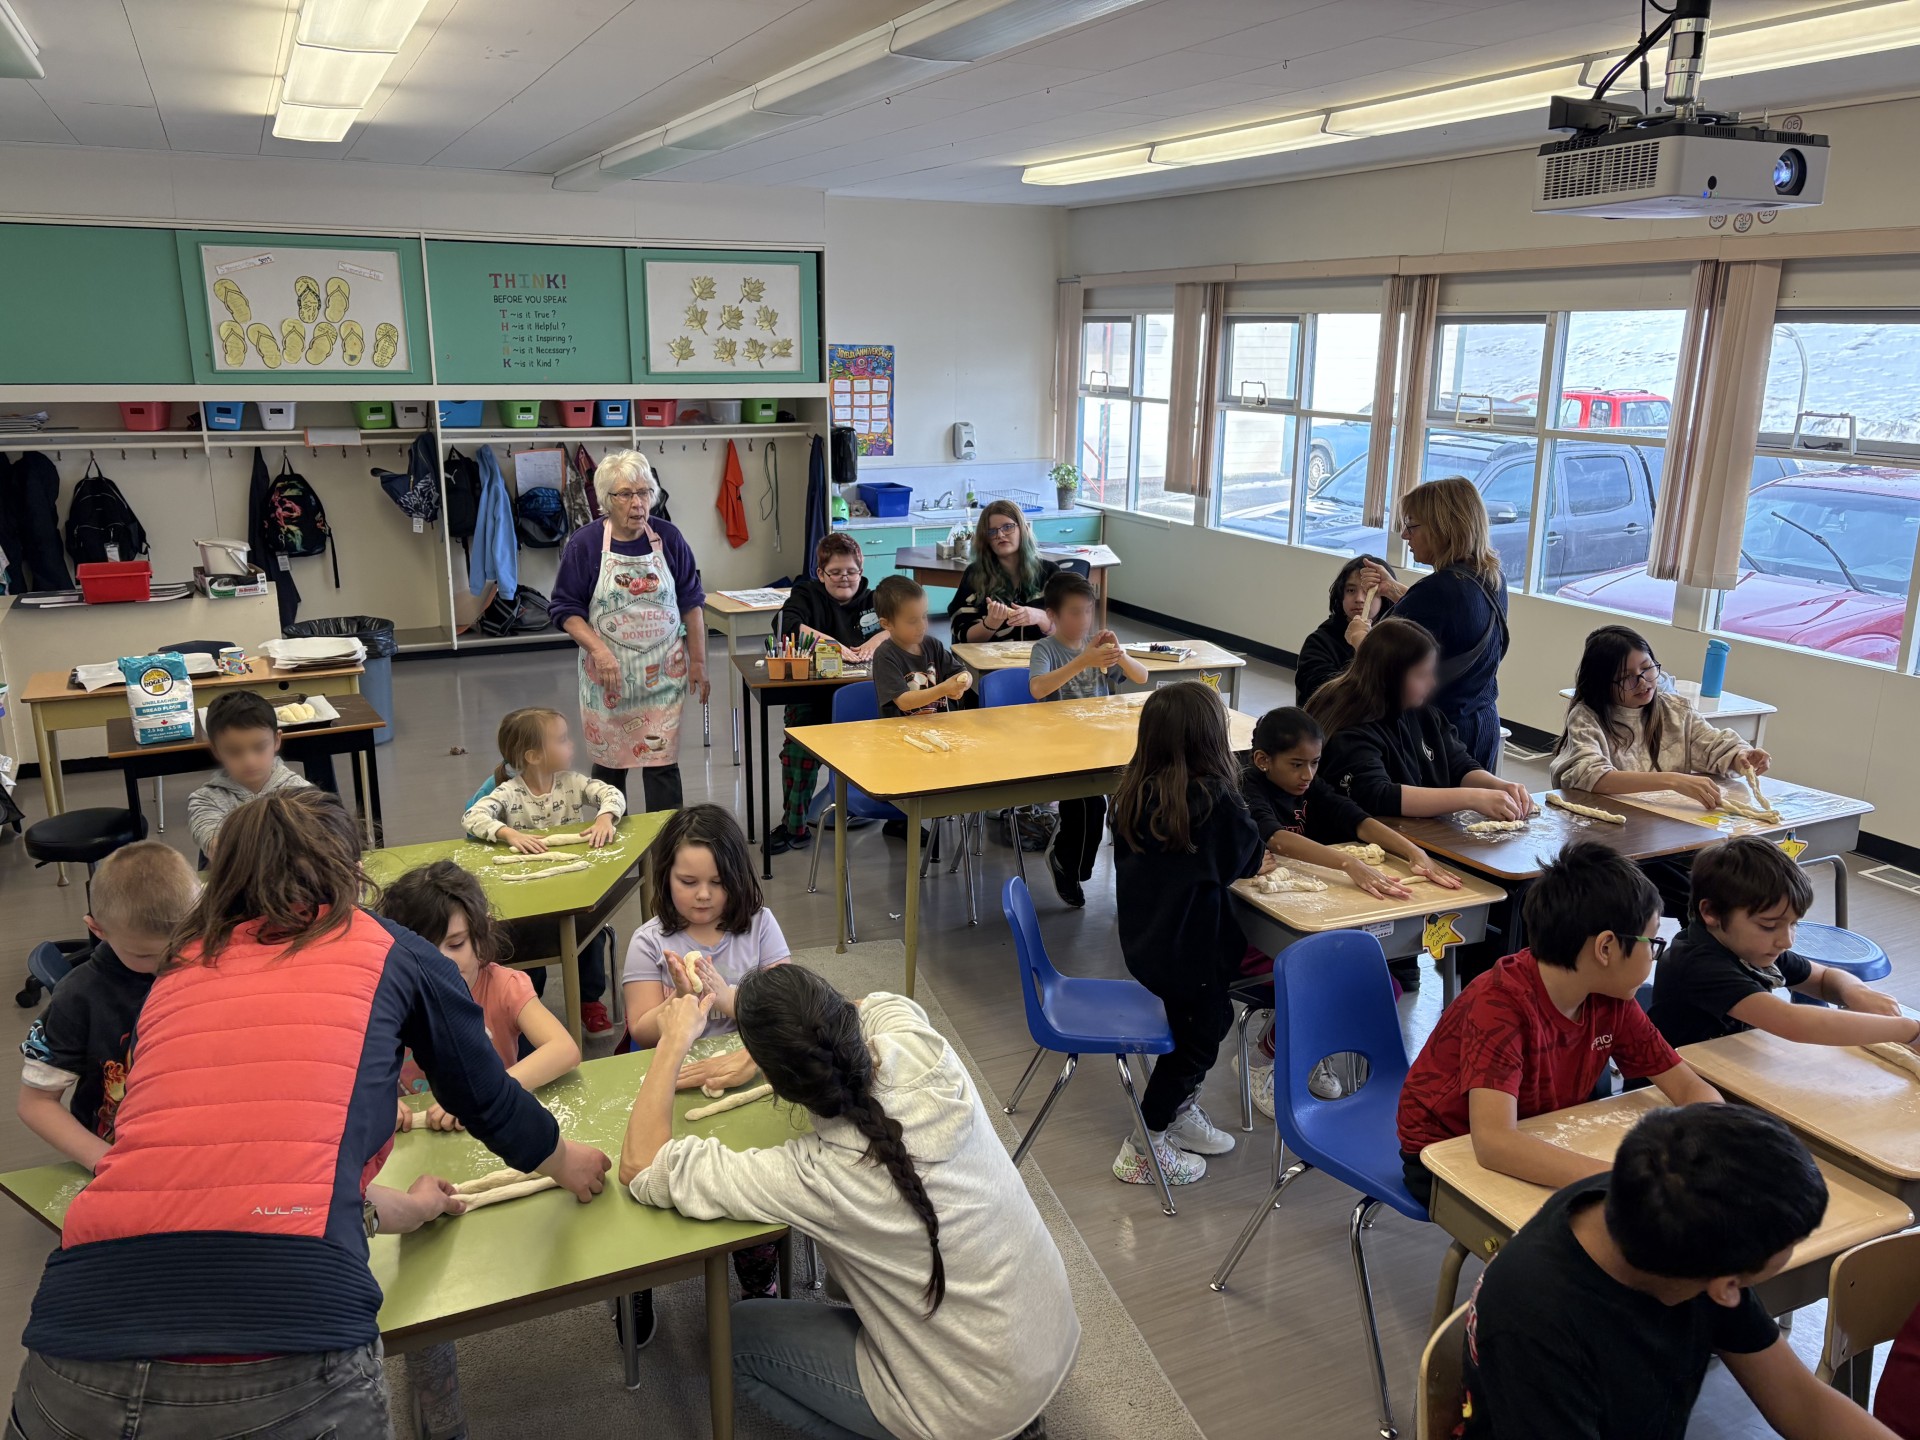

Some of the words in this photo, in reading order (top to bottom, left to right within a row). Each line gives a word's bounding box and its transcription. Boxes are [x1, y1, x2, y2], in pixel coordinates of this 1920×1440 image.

[488, 273, 566, 289] THINK!
[493, 295, 522, 304] BEFORE
[524, 296, 541, 304] YOU
[543, 296, 567, 304] SPEAK
[499, 309, 507, 318] T
[501, 322, 509, 331] H
[503, 358, 512, 368] K
[640, 610, 672, 622] VEGAS
[622, 628, 665, 640] DONUTS
